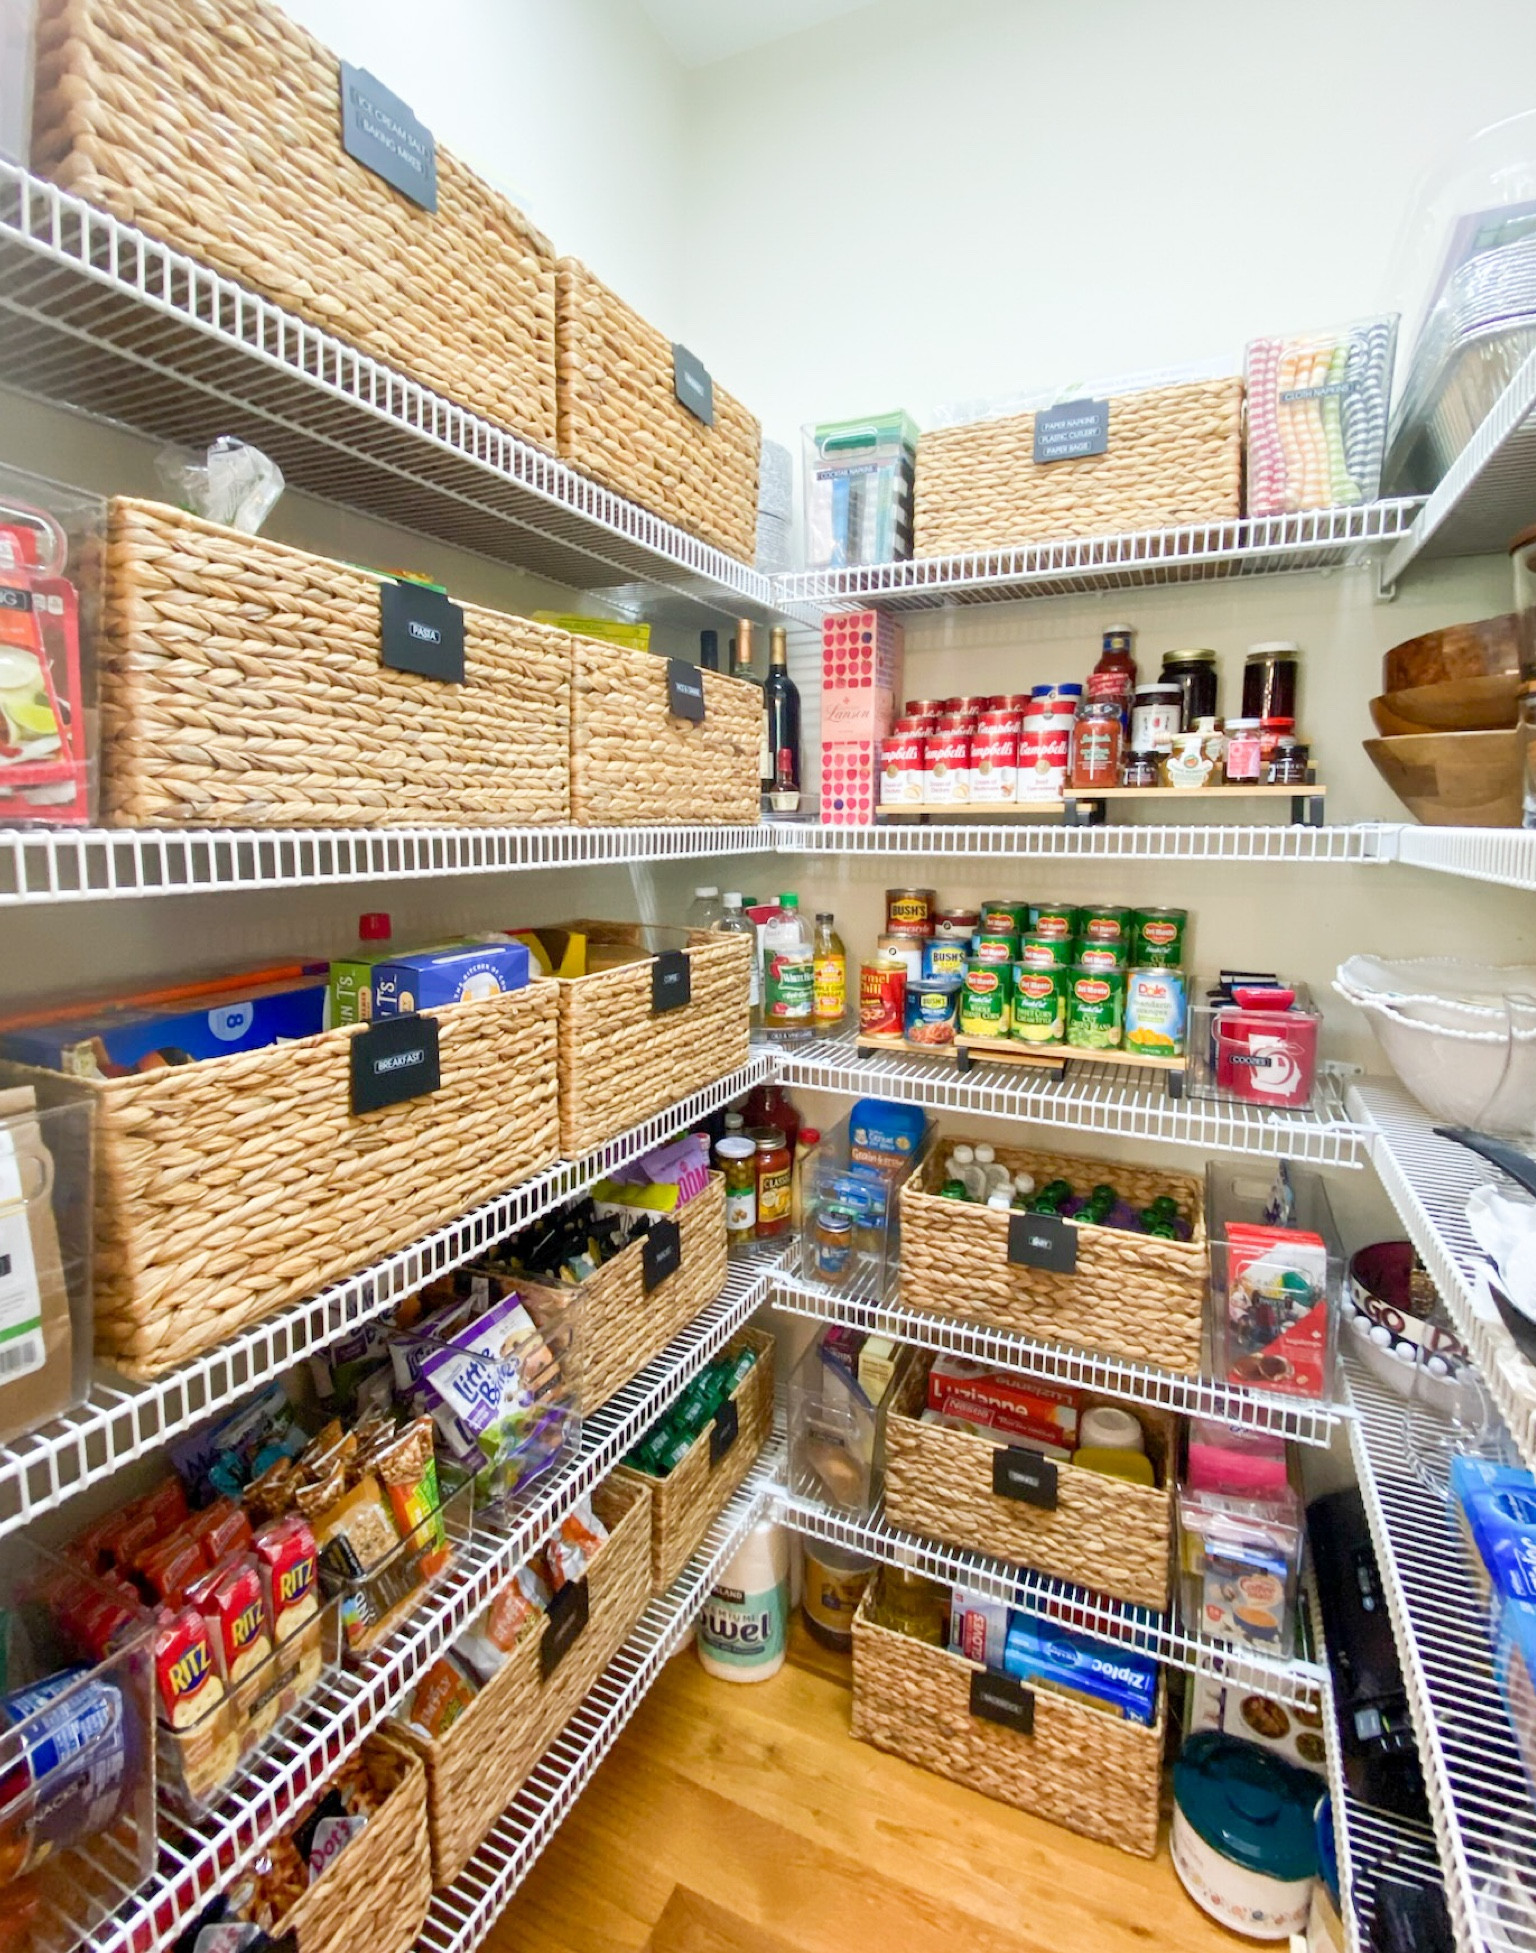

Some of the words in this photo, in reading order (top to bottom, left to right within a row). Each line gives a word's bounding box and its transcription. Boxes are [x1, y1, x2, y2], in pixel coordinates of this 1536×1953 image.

[1045, 421, 1066, 432] PAPER
[1067, 416, 1097, 429] NAPKINS
[1042, 432, 1068, 443] PLASTIC
[1069, 428, 1098, 441] CUTLERY
[1048, 445, 1067, 456] PAPER
[411, 623, 437, 641] PASTA
[892, 903, 926, 918] BUSH'S
[933, 951, 965, 963] BUSH'S
[1138, 983, 1167, 997] Dole
[378, 1051, 421, 1072] BREAKFAST
[280, 1555, 316, 1602] RITZ
[231, 1597, 264, 1649] RITZ
[971, 1614, 986, 1660] GLOVES
[169, 1639, 212, 1696] RITZ
[1090, 1658, 1146, 1690] Ziploc
